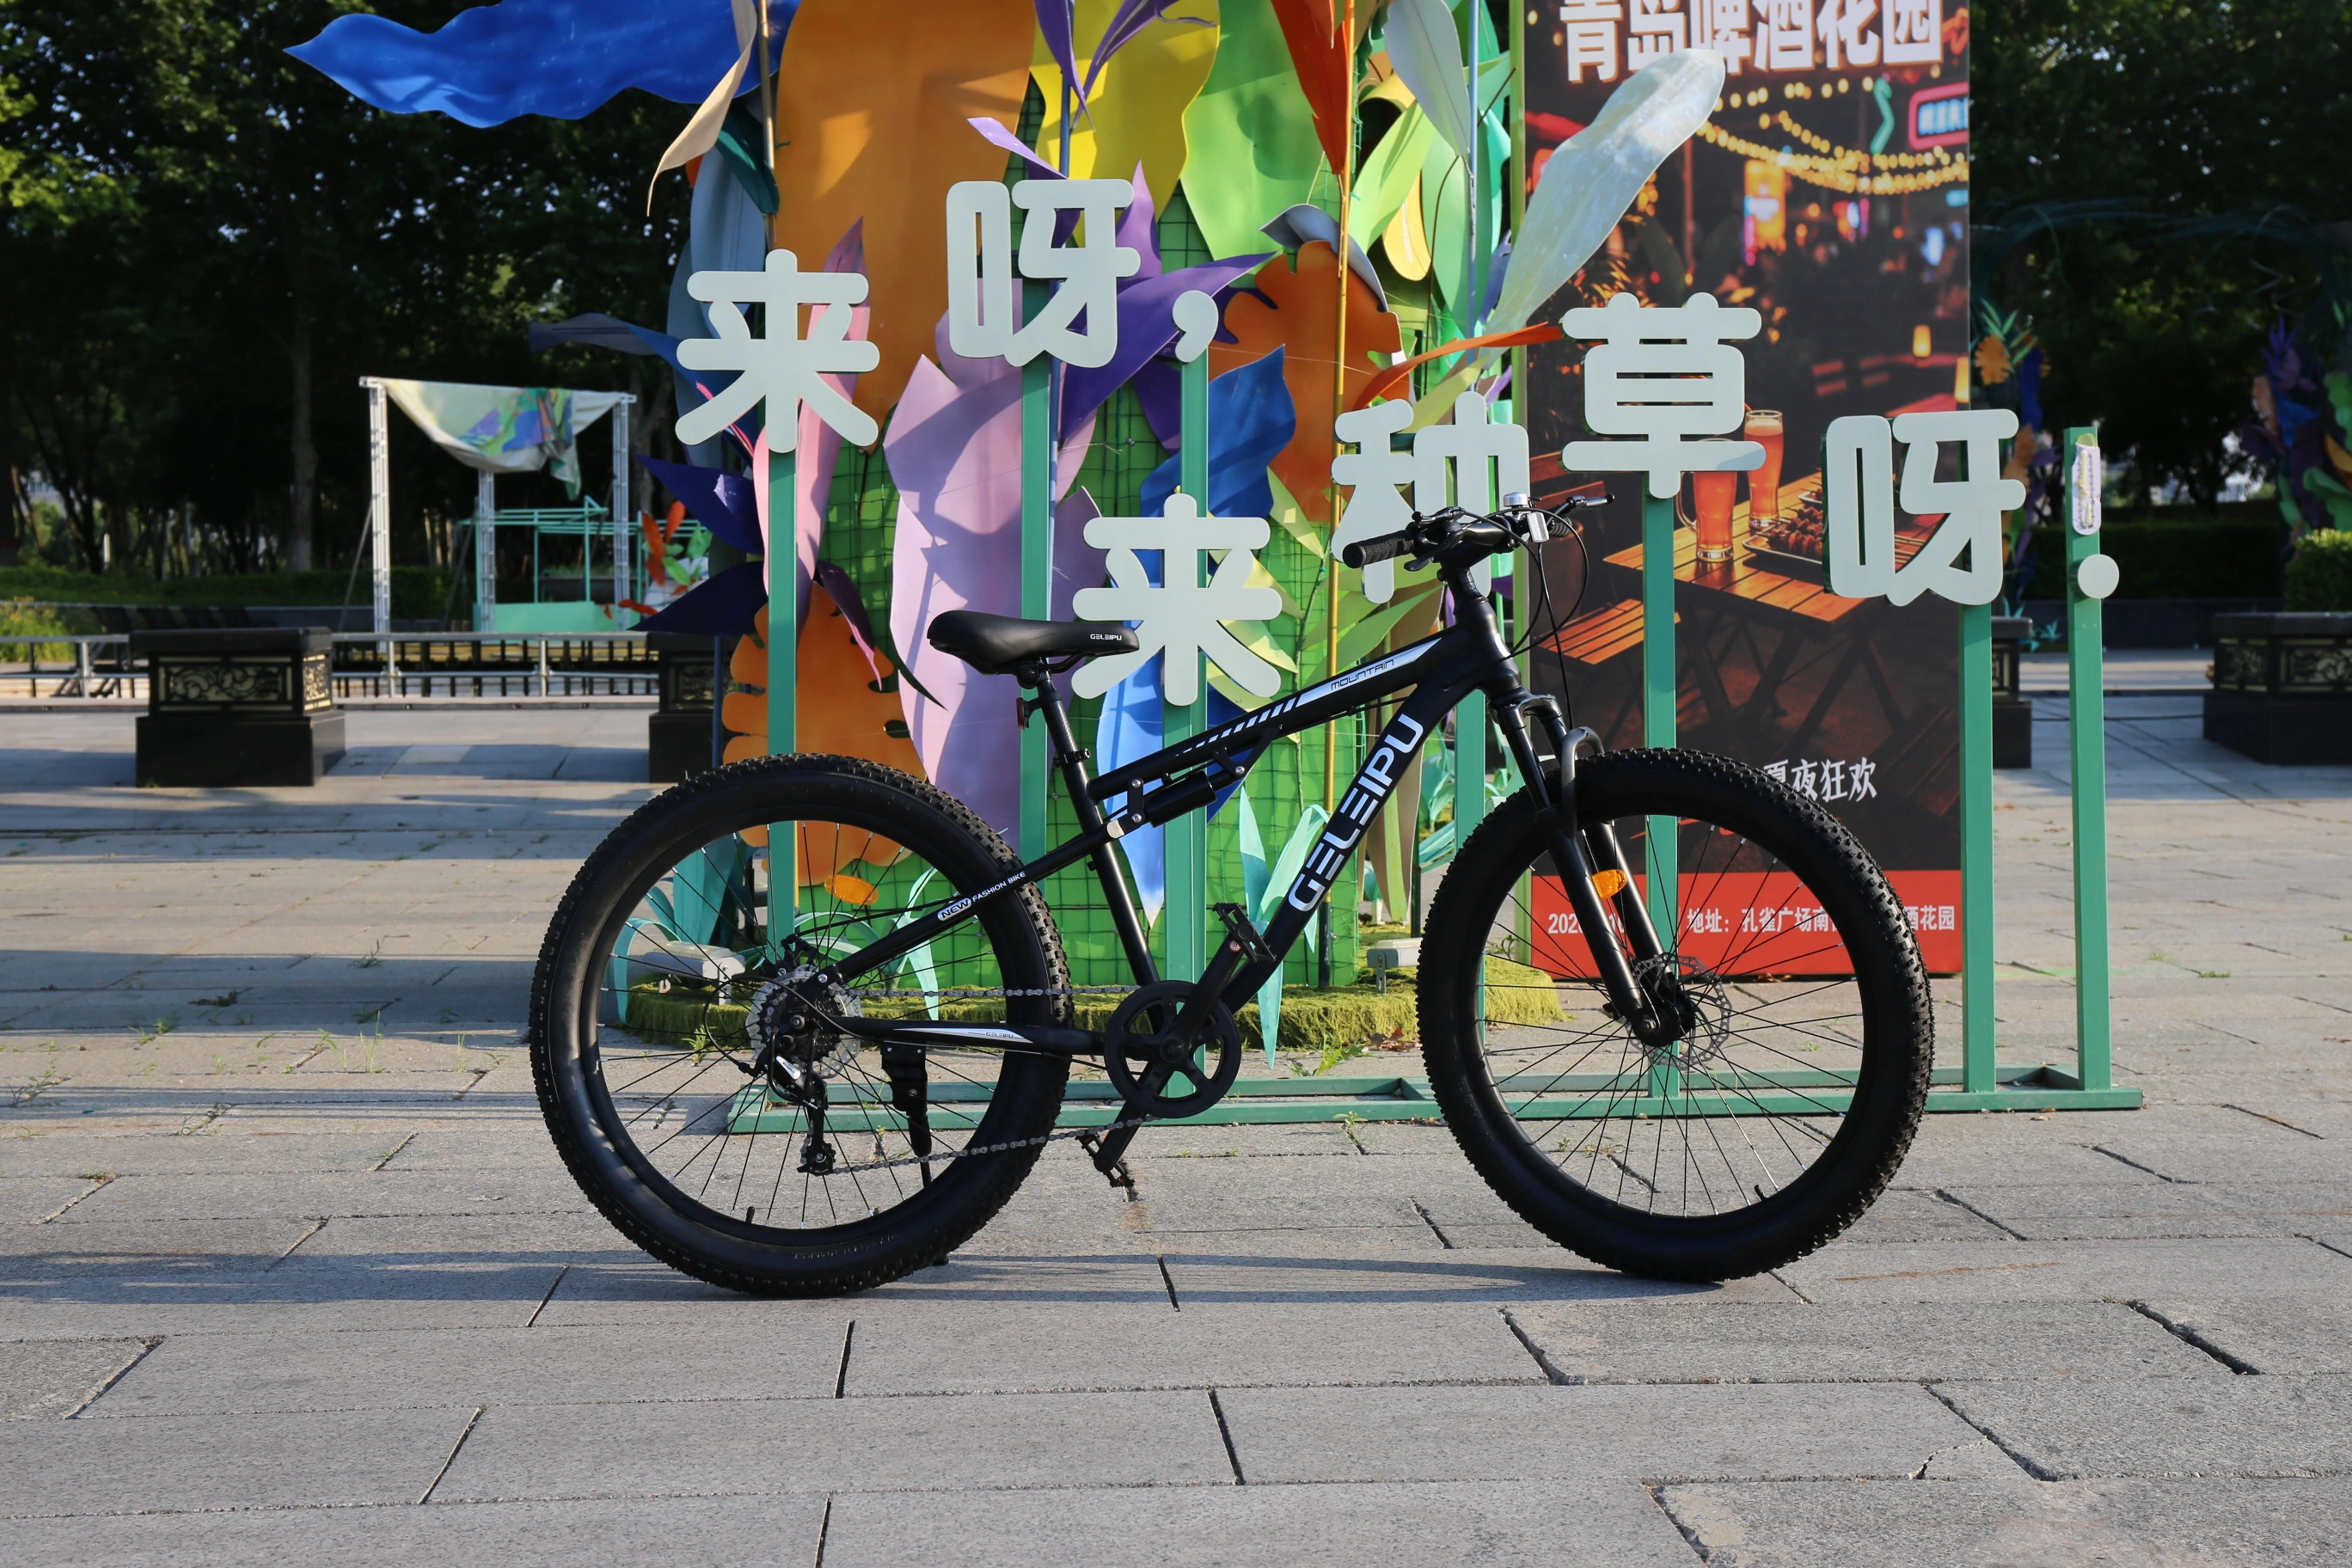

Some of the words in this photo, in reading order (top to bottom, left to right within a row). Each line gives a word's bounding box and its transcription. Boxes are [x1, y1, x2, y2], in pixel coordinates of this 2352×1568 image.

[1559, 0, 1943, 83] 青岛啤酒花园
[1331, 658, 1394, 690] MOUNTAIN
[1288, 714, 1424, 912] GELEIPU
[940, 898, 971, 919] NEW
[972, 880, 1007, 903] FASHION
[1008, 871, 1026, 885] BIKE
[1547, 913, 1583, 934] 202
